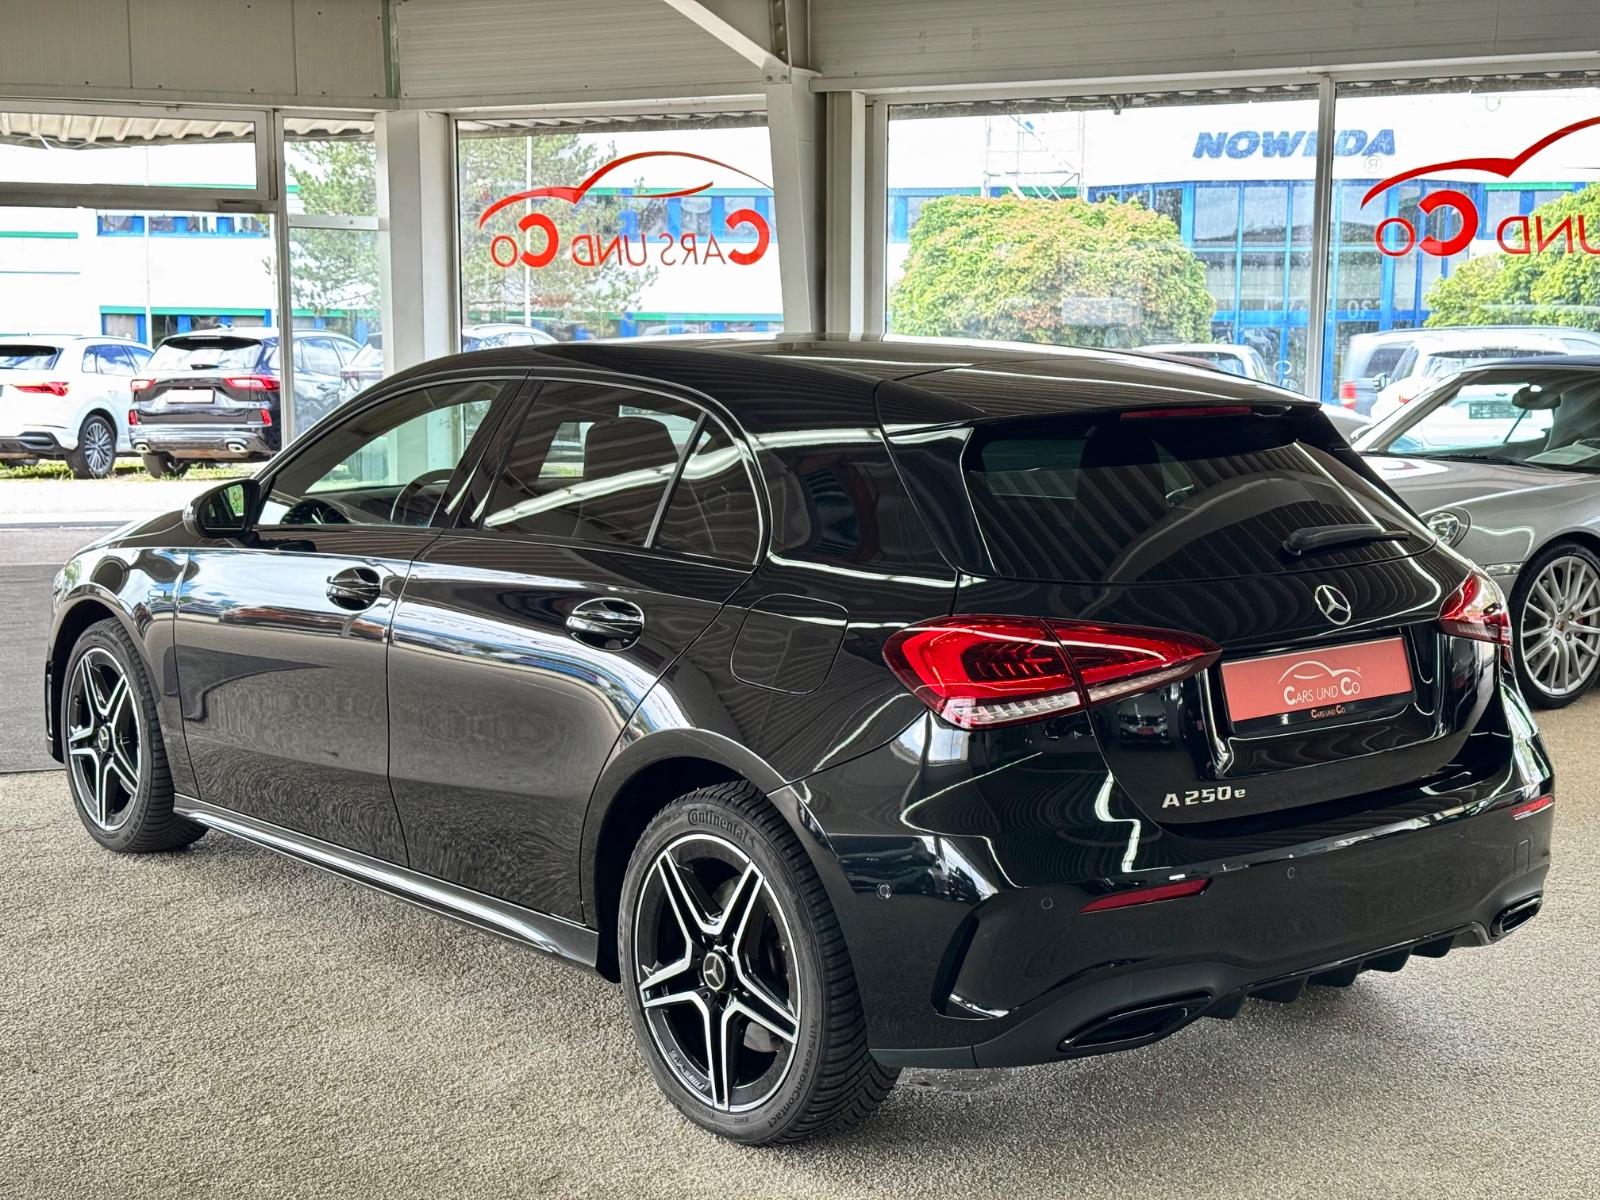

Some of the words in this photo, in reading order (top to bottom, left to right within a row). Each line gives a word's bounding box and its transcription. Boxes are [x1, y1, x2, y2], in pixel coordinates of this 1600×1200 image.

[1316, 685, 1339, 701] UND
[1161, 793, 1180, 809] A
[688, 808, 748, 843] Continental
